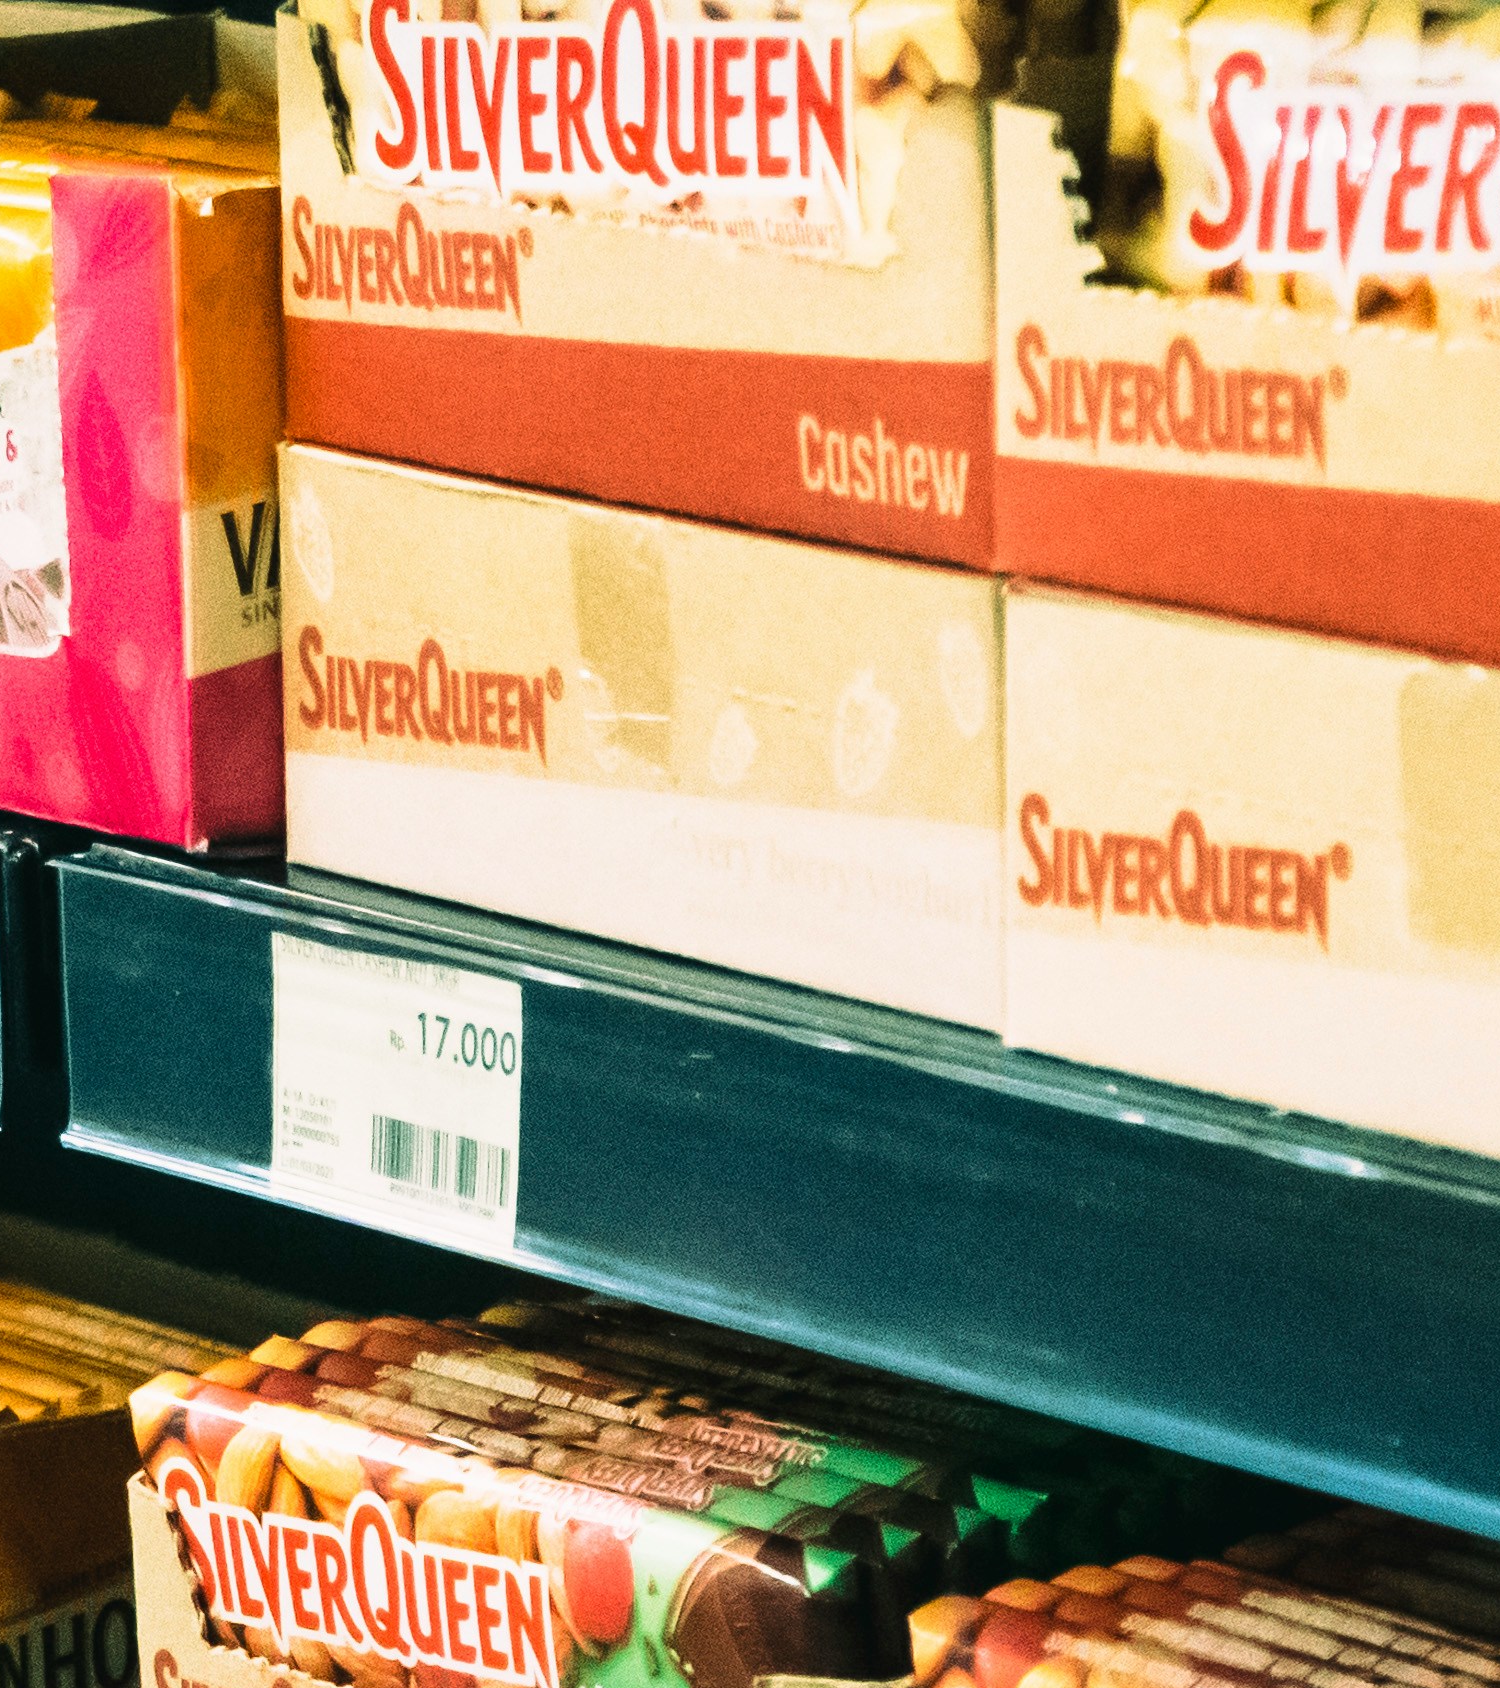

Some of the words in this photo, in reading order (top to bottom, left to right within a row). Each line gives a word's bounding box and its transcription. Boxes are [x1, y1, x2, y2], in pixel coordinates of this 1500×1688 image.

[364, 0, 848, 195] SILVERQUEEN
[291, 196, 524, 324] SILVERQUEEN
[798, 412, 969, 518] Cashew
[1014, 325, 1328, 470] SILVERQUEEN
[296, 626, 549, 768] SILVERQUEEN
[1017, 792, 1330, 951] SILVERQUEEN
[417, 1012, 516, 1076] 17.000
